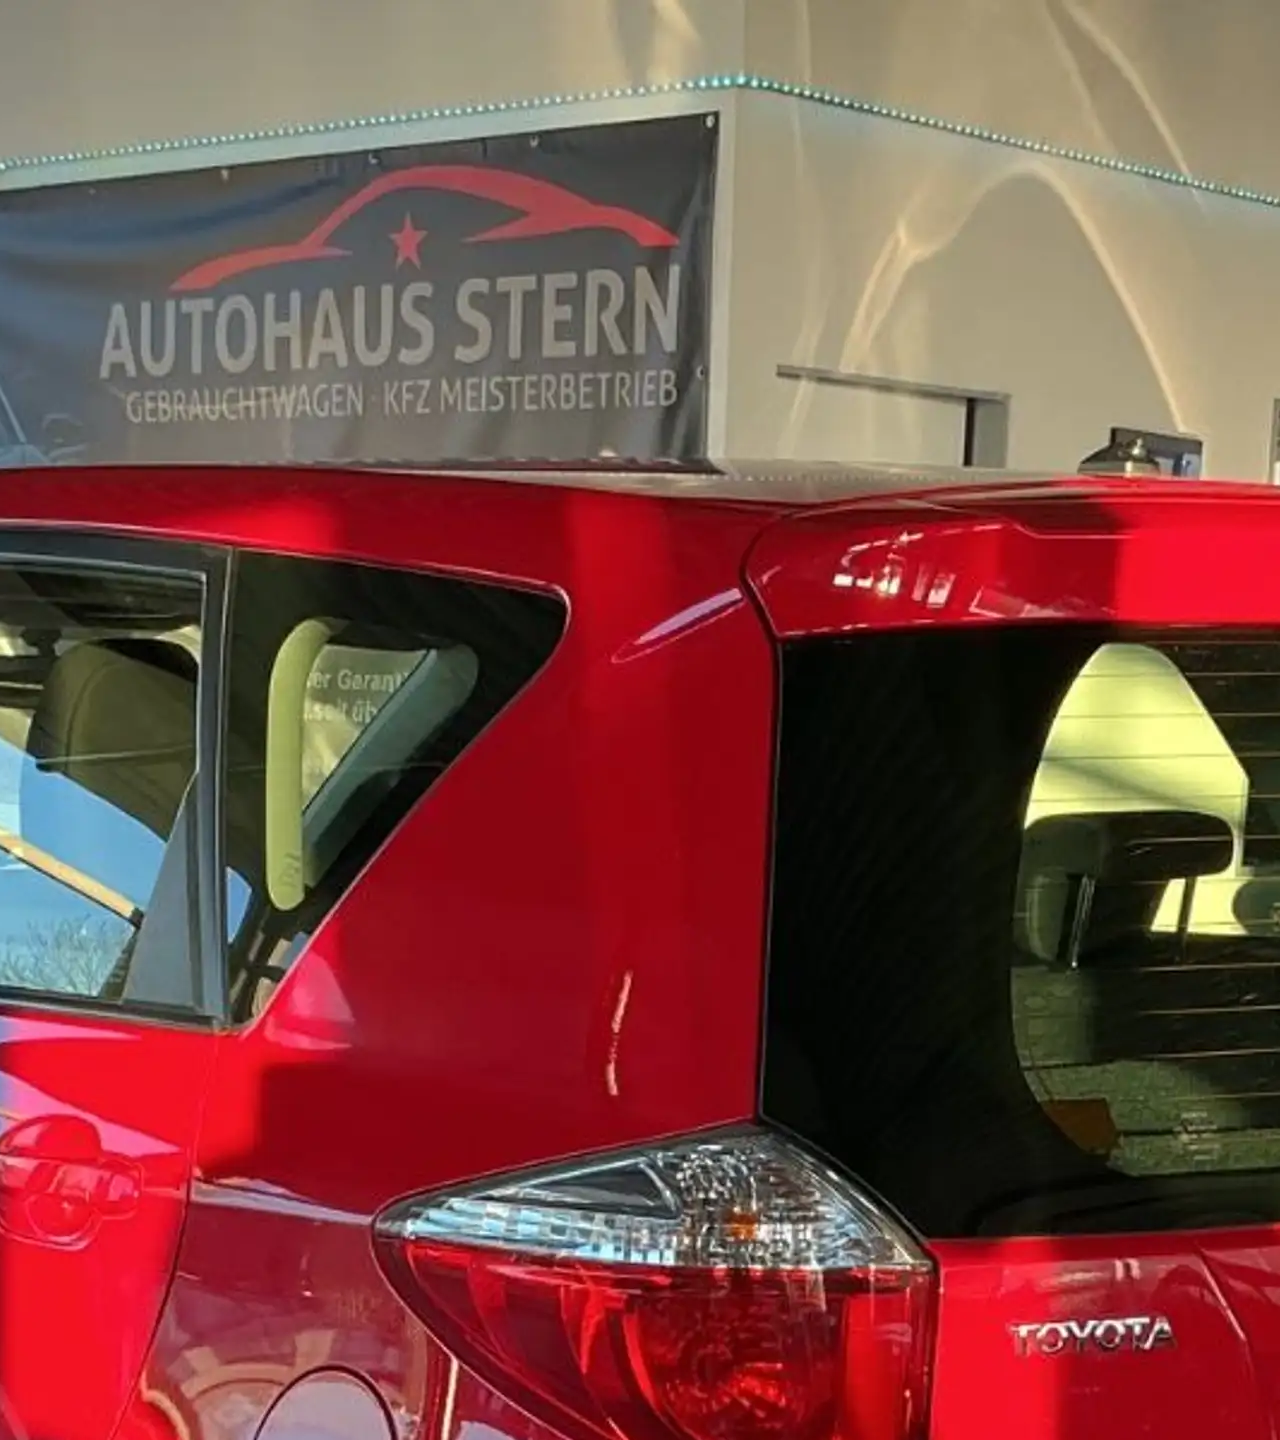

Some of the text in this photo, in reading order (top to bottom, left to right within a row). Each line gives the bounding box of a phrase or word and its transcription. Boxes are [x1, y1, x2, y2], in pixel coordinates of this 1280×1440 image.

[100, 264, 680, 379] AUTOHAUS STERN
[126, 369, 678, 423] GEBRAUCHTWAGEN KFZ MEISTERBETRIEB
[1006, 1316, 1178, 1357] TOYOTA
